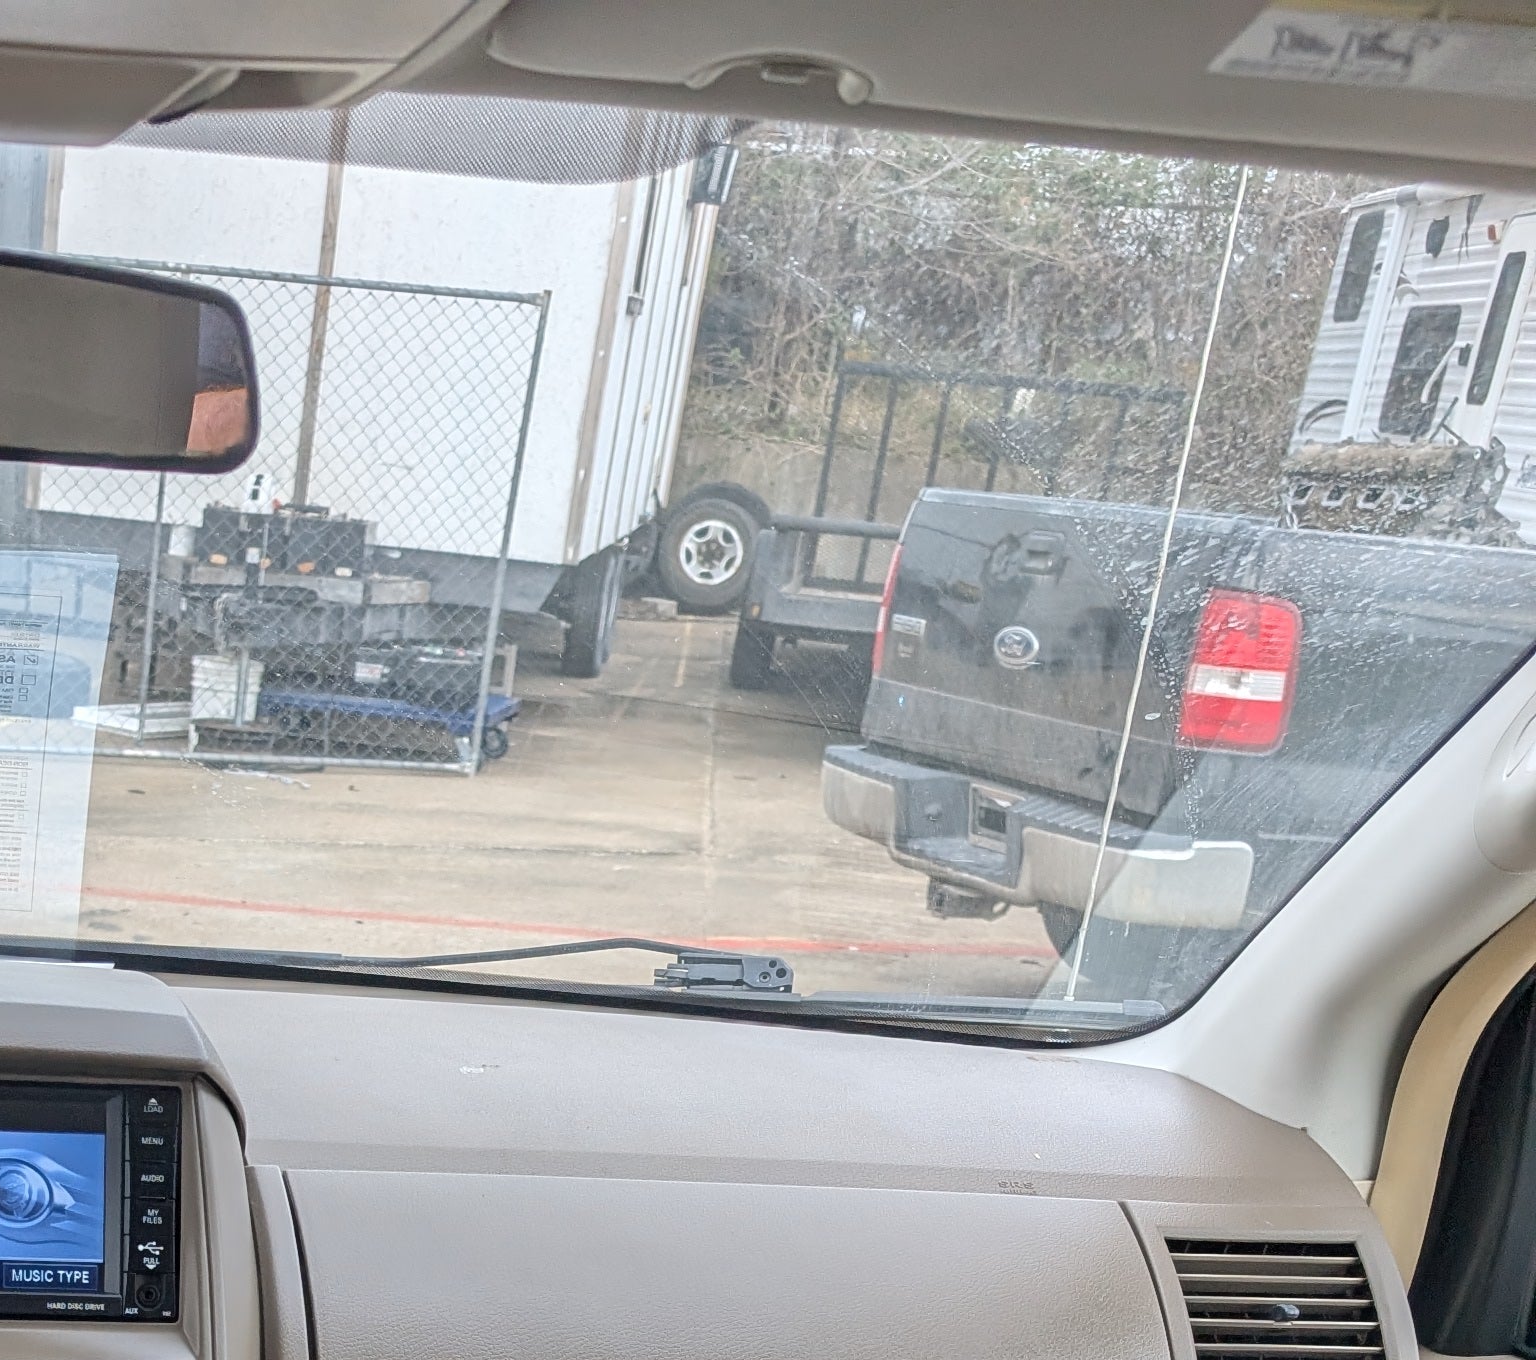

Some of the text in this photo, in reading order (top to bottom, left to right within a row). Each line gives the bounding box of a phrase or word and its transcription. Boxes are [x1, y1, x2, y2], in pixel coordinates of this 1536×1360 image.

[144, 1105, 164, 1113] LOAD
[141, 1136, 164, 1146] MENU
[140, 1174, 165, 1183] AUDIO
[147, 1208, 160, 1217] MY
[142, 1215, 163, 1225] FILES
[143, 1257, 161, 1265] PULL
[12, 1269, 90, 1284] MUSIC TYPE
[47, 1302, 67, 1310] HARD
[124, 1307, 139, 1315] AUX
